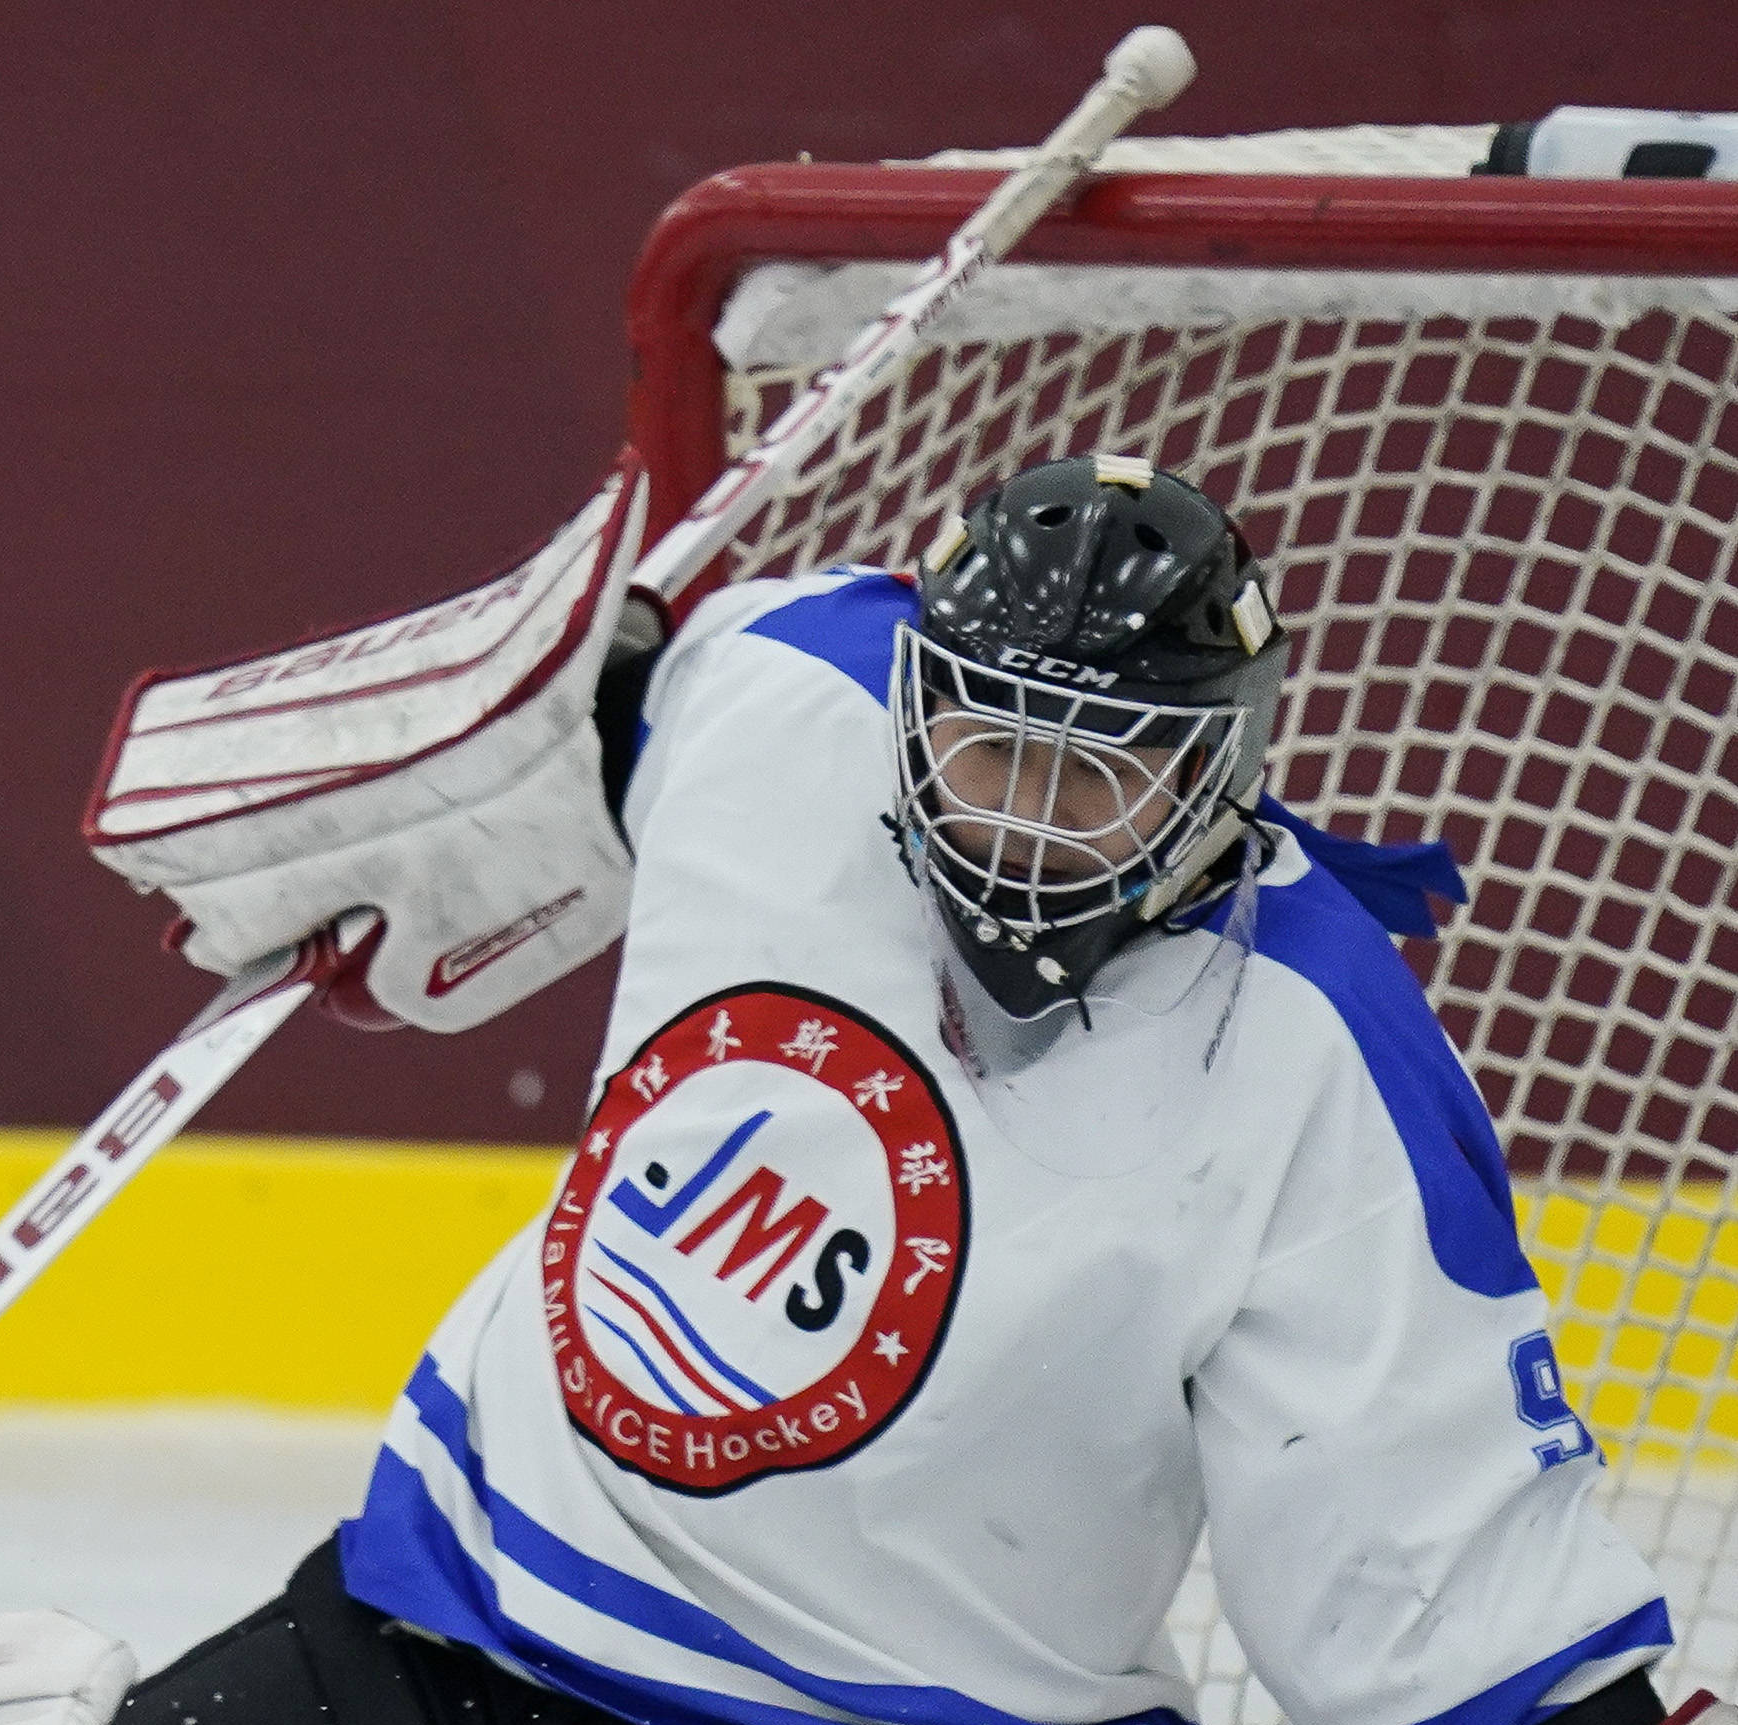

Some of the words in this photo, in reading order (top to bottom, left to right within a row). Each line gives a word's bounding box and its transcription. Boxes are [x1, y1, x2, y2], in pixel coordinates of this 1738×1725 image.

[999, 646, 1119, 690] CCM
[609, 1111, 873, 1332] JMS
[685, 1381, 869, 1471] Hockey
